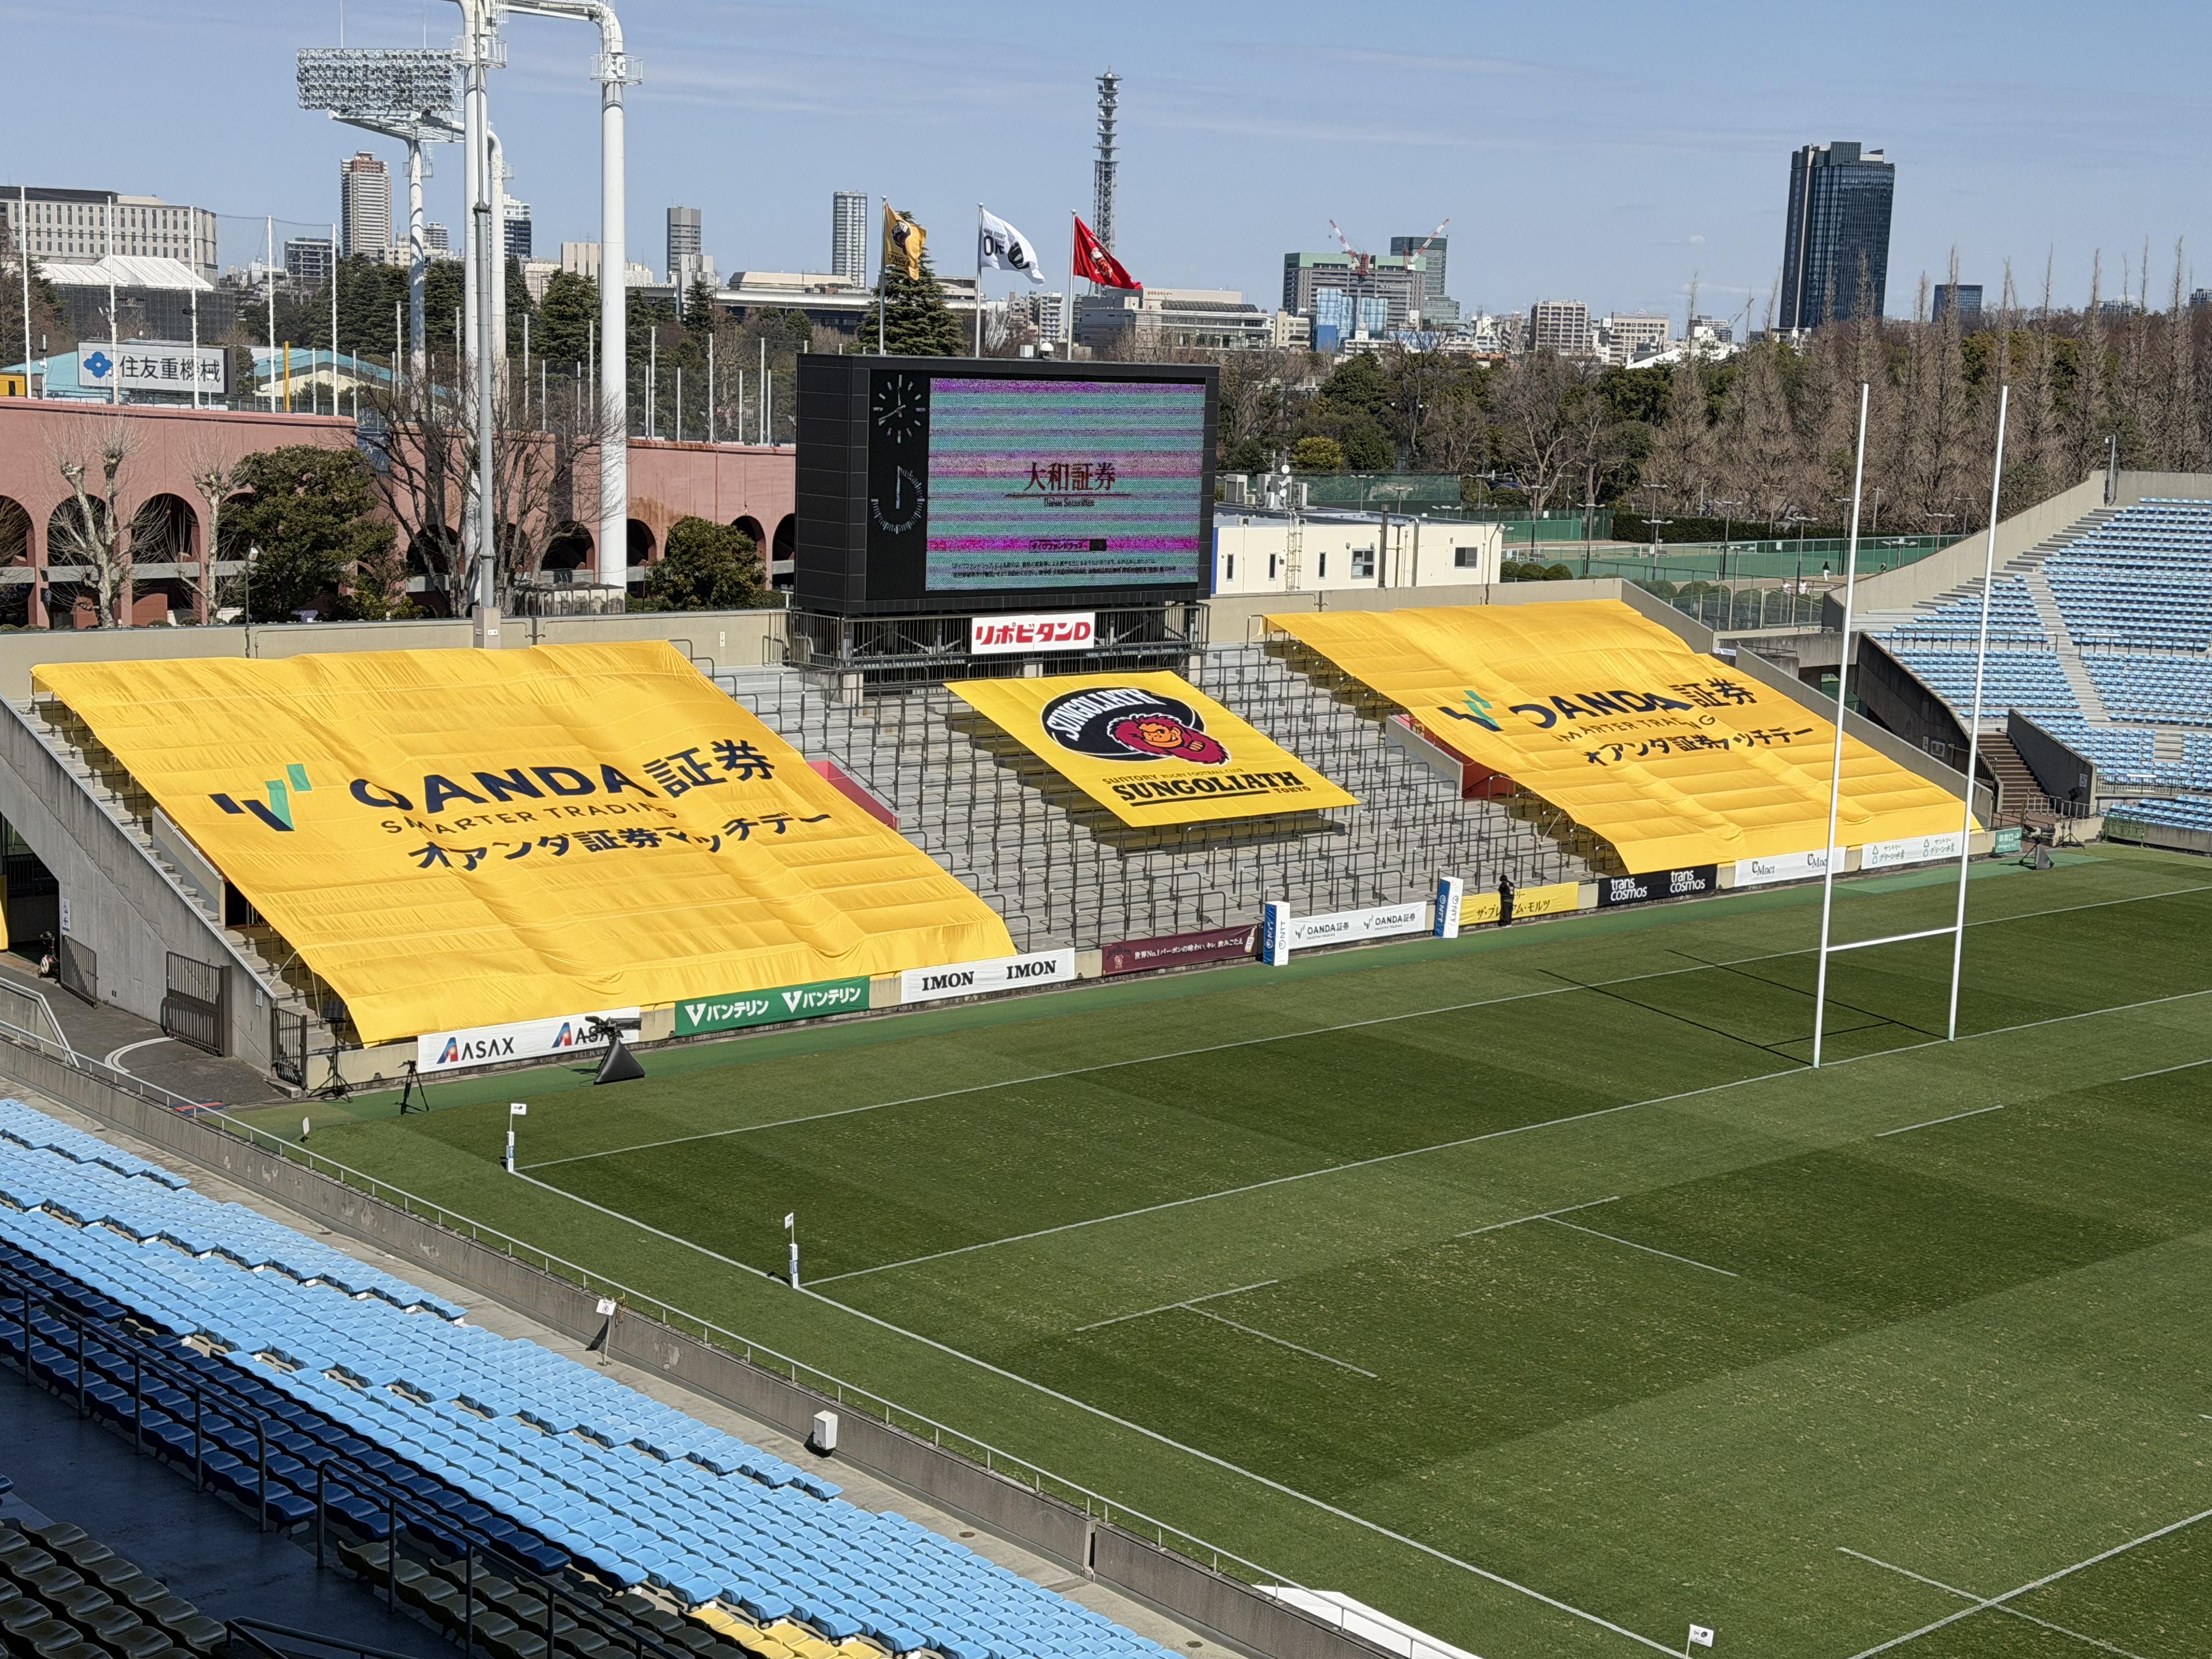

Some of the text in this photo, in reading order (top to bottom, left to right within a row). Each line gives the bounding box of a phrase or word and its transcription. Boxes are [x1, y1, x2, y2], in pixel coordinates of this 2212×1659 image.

[119, 356, 221, 383] 住友重機械
[1023, 462, 1116, 491] 大和証券
[975, 622, 1091, 646] リポビタンD
[1046, 689, 1167, 741] SUNGOLIATH
[1552, 714, 1716, 742] MARTER TRANG
[1102, 774, 1157, 785] SUNTORY
[1112, 771, 1305, 802] SUNGOLIATH
[1274, 786, 1312, 794] TOKYO
[381, 801, 677, 834] SMARTER TRADING
[1610, 878, 1635, 890] trans
[1669, 878, 1706, 893] cosmos
[1670, 870, 1694, 883] trans
[1610, 886, 1647, 901] cosmos
[1476, 899, 1551, 920] ザ・プレム・モルツ
[1006, 960, 1057, 980] IMON
[922, 971, 975, 991] IMON
[803, 988, 861, 1008] バンテリン
[707, 1000, 769, 1022] バンテリン
[575, 1026, 624, 1045] AS
[461, 1037, 515, 1061] ASAX
